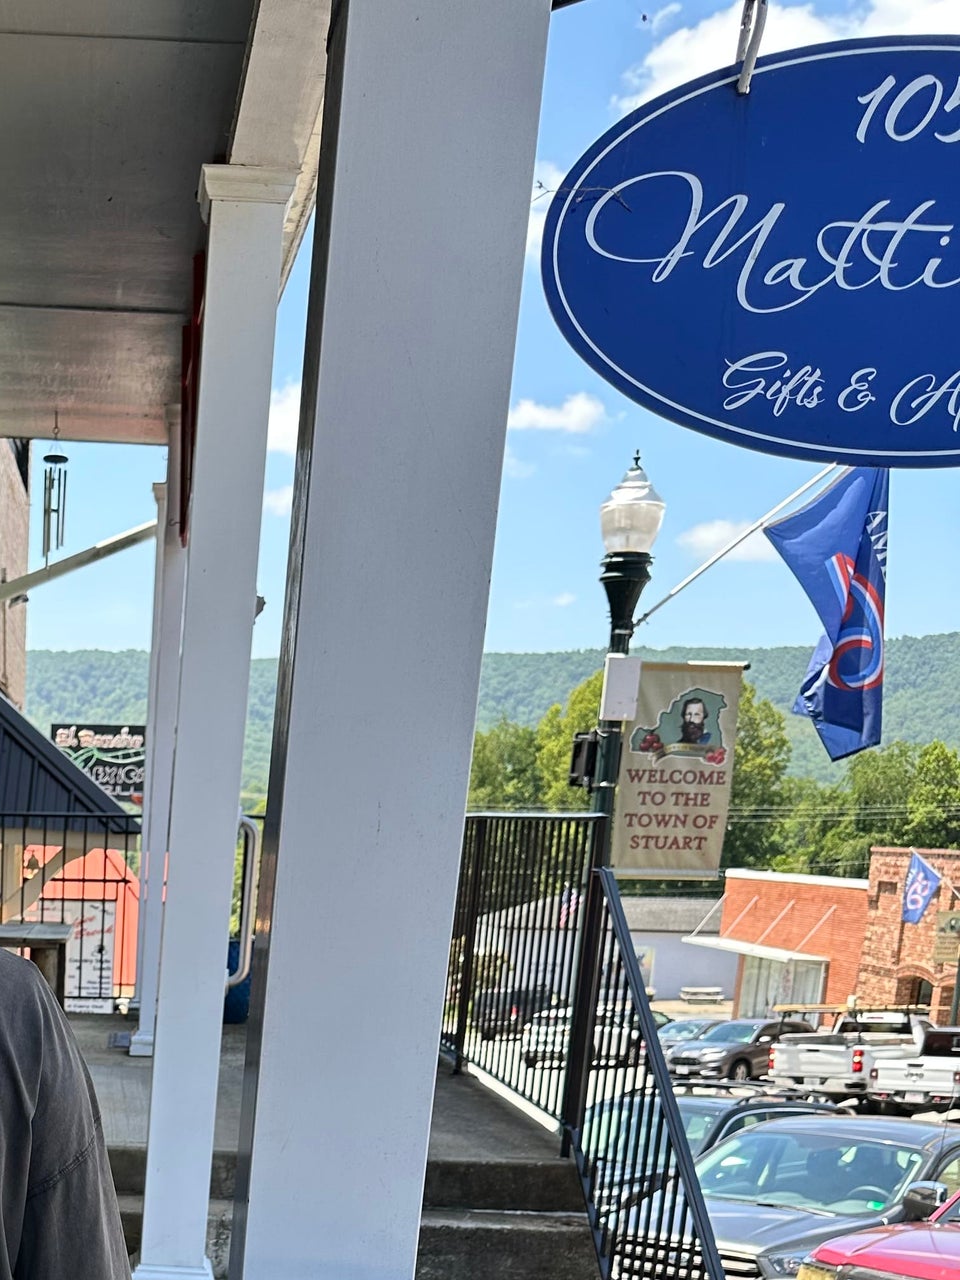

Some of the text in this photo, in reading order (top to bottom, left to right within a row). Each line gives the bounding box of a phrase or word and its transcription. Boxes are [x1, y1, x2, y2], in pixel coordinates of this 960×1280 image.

[722, 351, 826, 417] Gifts
[837, 367, 877, 412] &
[626, 768, 727, 786] WELCOME
[637, 791, 711, 807] TO THE
[624, 813, 719, 829] TOWN OF
[629, 835, 708, 851] STUART
